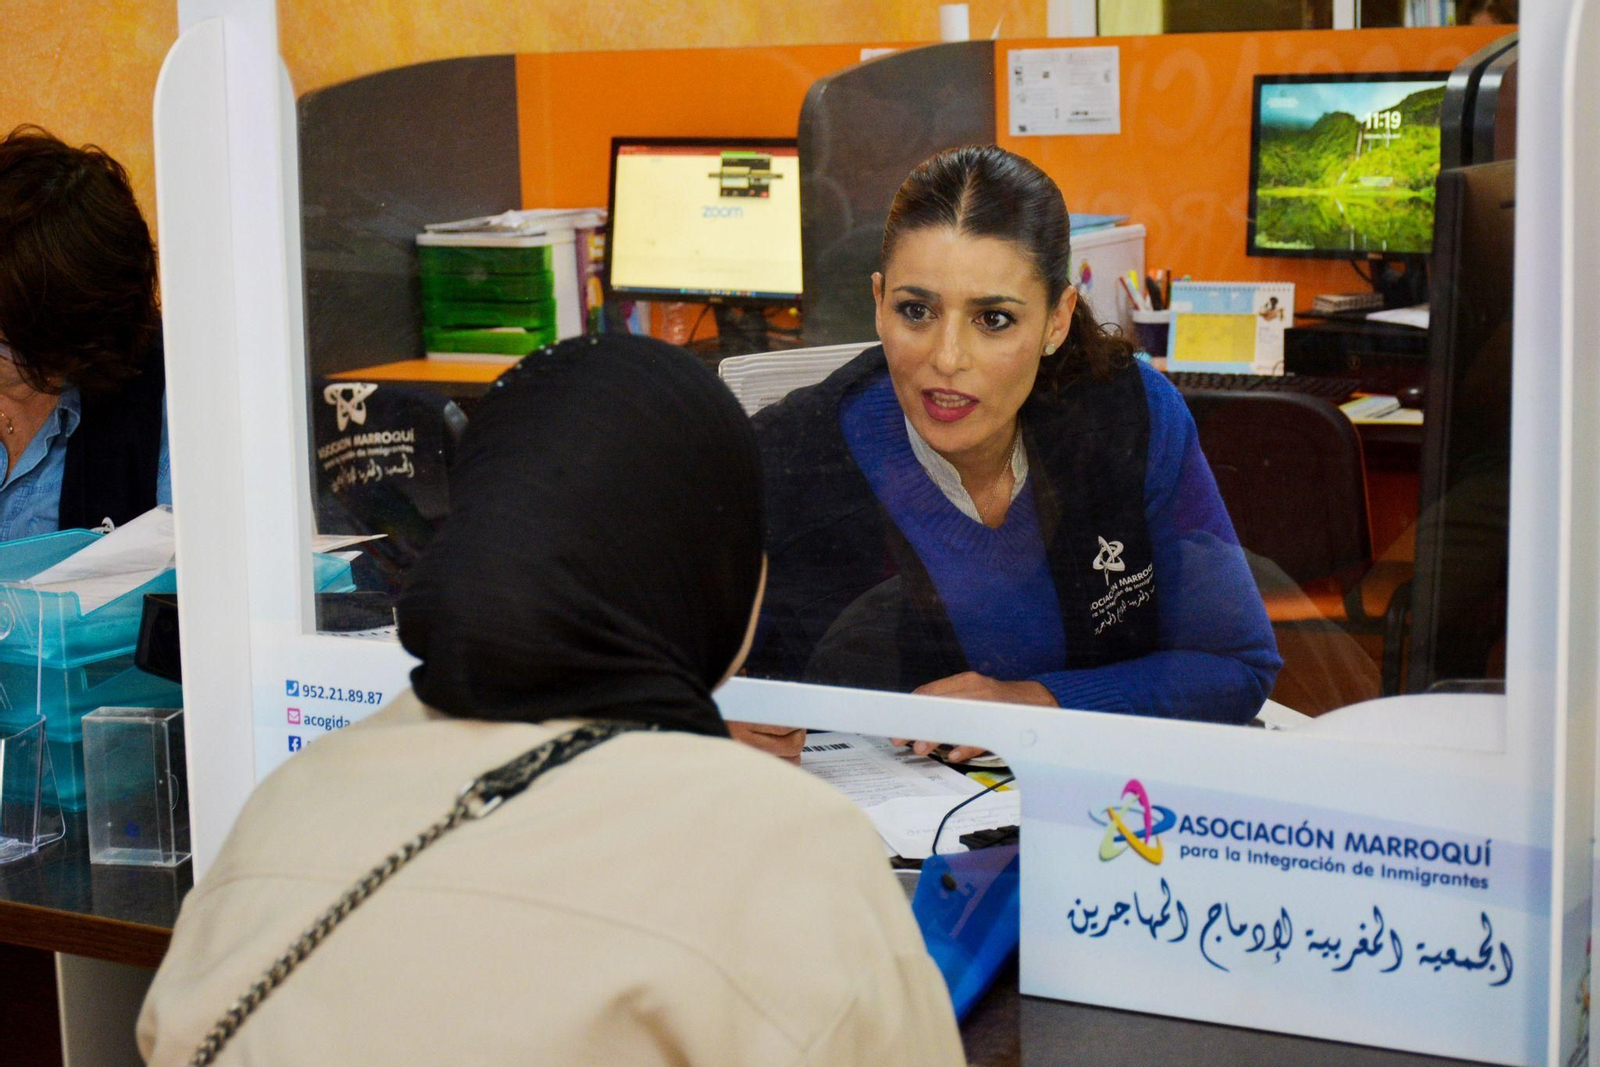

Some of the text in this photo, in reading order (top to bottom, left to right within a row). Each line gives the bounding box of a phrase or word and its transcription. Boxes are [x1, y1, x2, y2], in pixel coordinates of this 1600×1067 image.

[1365, 110, 1402, 130] 11:19
[702, 205, 743, 219] zoom
[302, 684, 383, 705] 952.21.89.87
[1178, 814, 1492, 867] ASOCIACIÓN MARROQUÍ
[1180, 845, 1489, 890] para la Integración de Inmigrantes
[1067, 877, 1514, 987] الجمعية المغربية لإدماج المهاجرين
